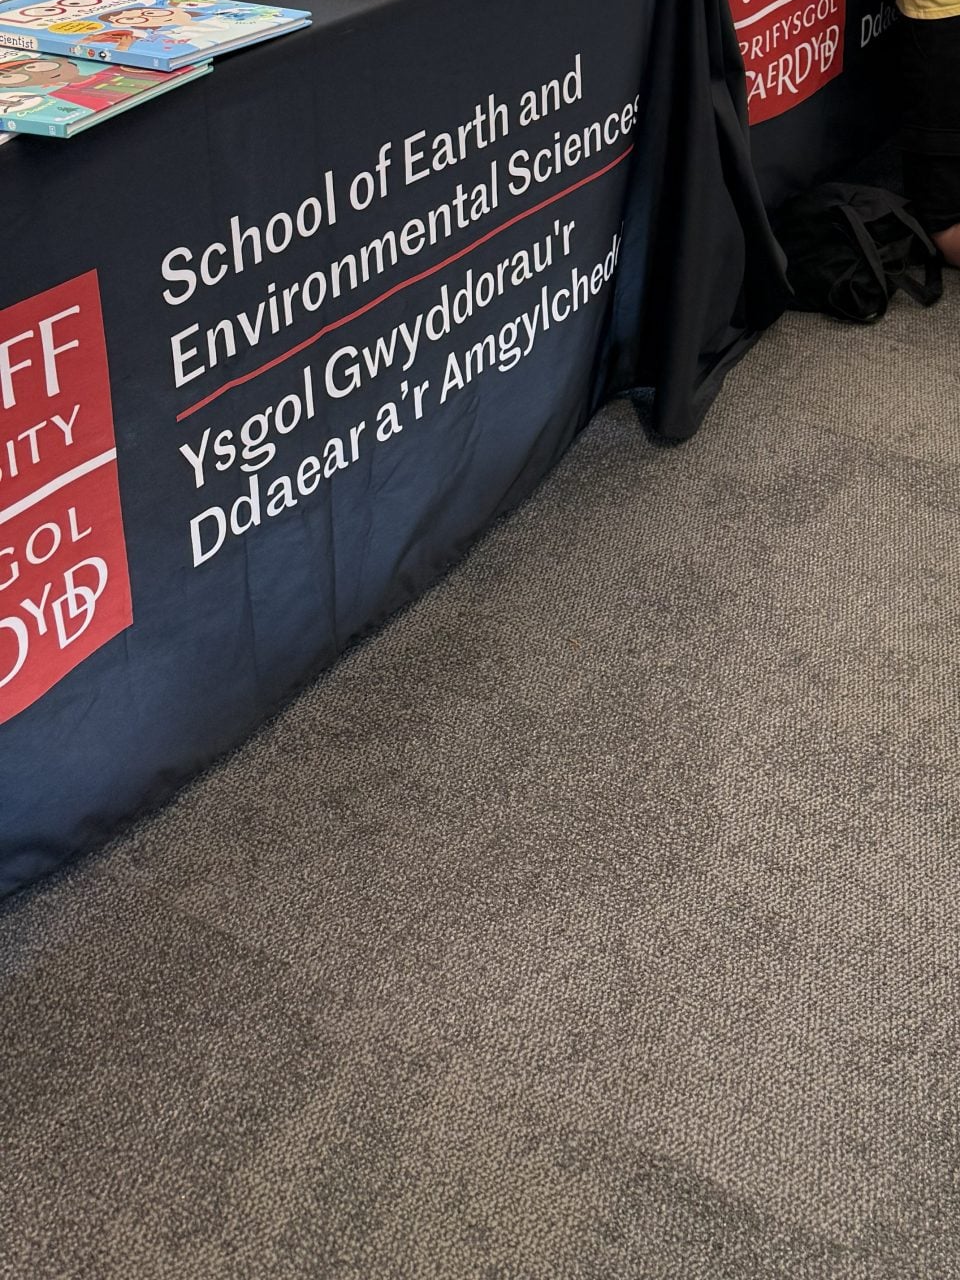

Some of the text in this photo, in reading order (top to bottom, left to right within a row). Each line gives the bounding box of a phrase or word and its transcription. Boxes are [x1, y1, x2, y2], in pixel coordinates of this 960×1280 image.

[0, 35, 33, 48] cientist
[161, 53, 582, 306] School of Earth and
[170, 160, 498, 389] Environmental
[179, 365, 314, 489] Ysgol
[324, 219, 575, 400] Gwyddorau'r
[189, 421, 366, 569] Ddaear
[375, 378, 430, 453] a'r
